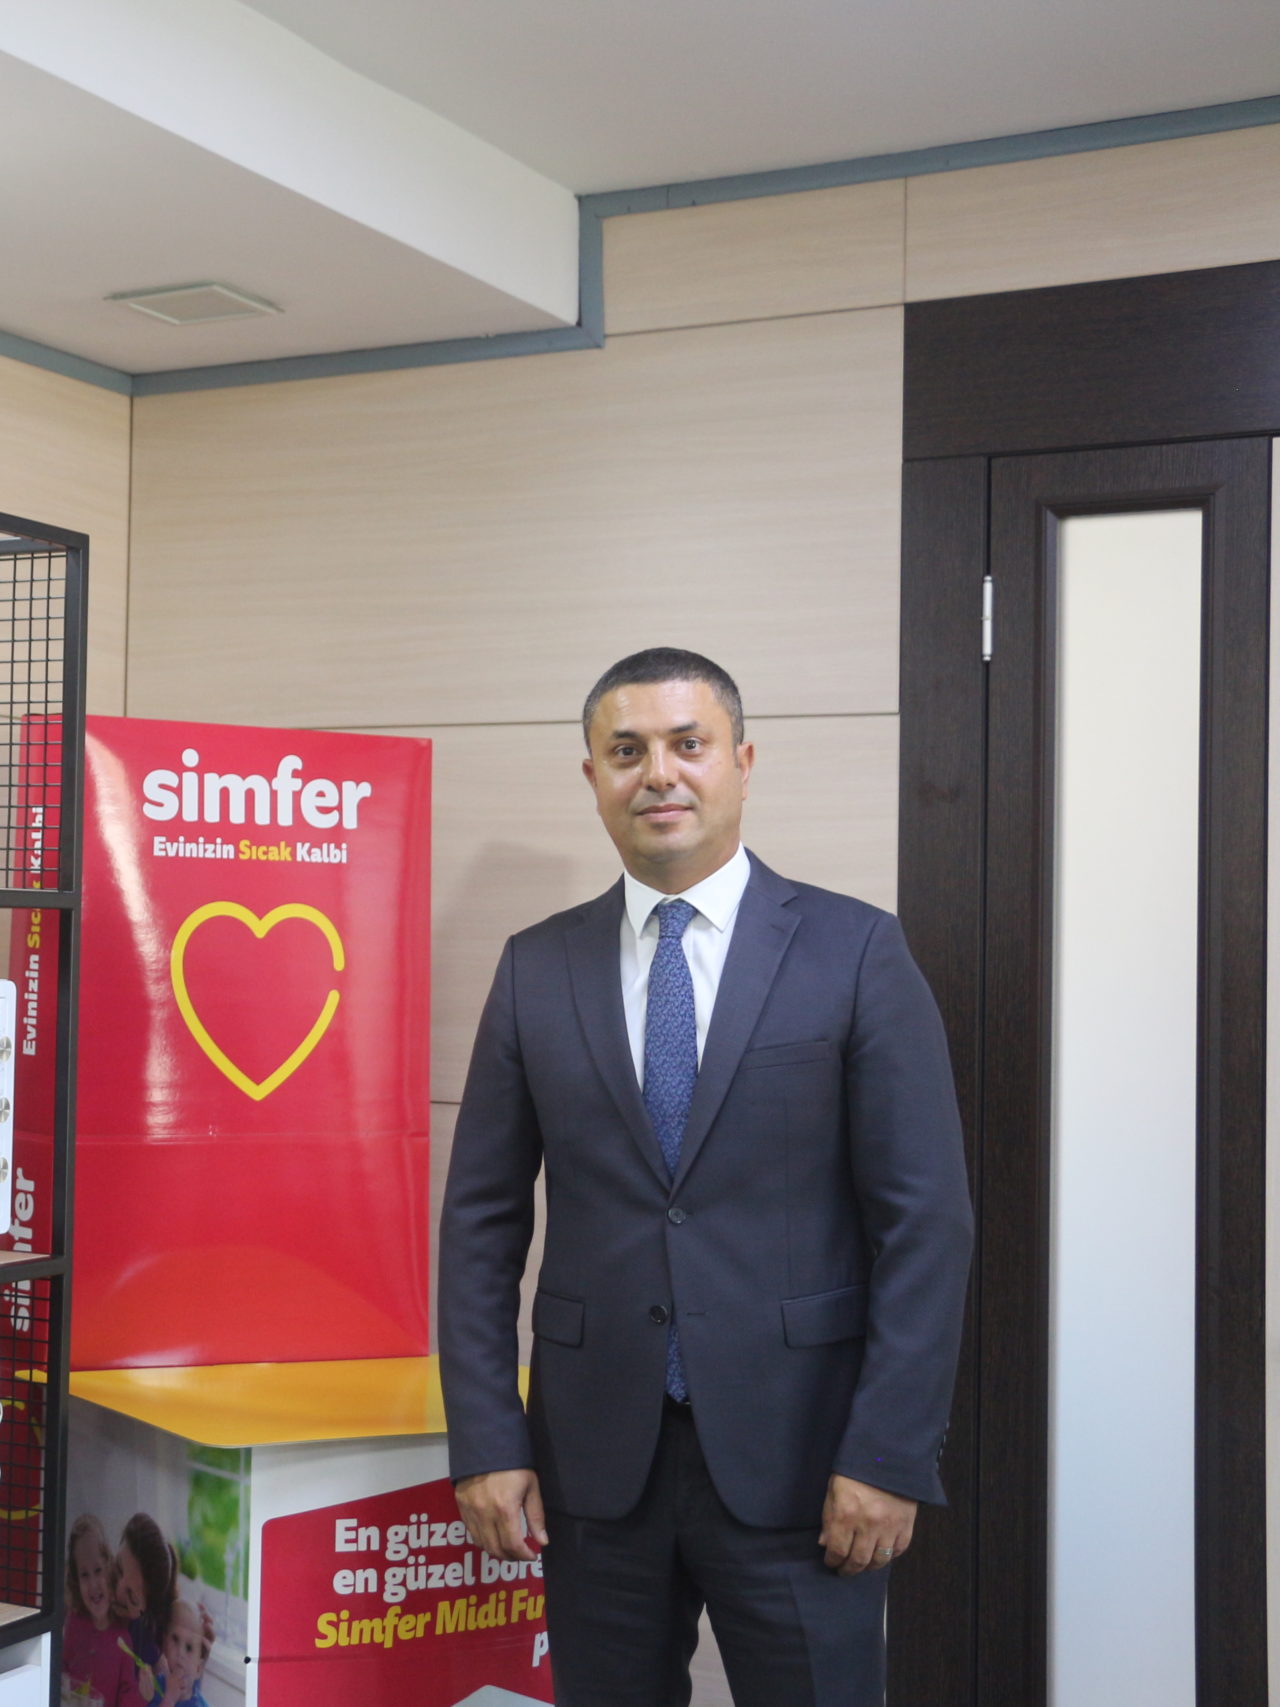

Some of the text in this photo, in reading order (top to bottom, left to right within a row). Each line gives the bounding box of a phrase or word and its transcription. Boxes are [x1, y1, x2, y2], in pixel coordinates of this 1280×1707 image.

[142, 748, 372, 830] simfer
[153, 836, 348, 864] Evinizin Sıcak Kalbi
[22, 953, 40, 1056] Evinizin
[335, 1518, 380, 1552] En
[332, 1566, 378, 1595] en
[382, 1551, 476, 1603] güzel
[314, 1605, 432, 1649] Simfer
[435, 1590, 507, 1635] Midi
